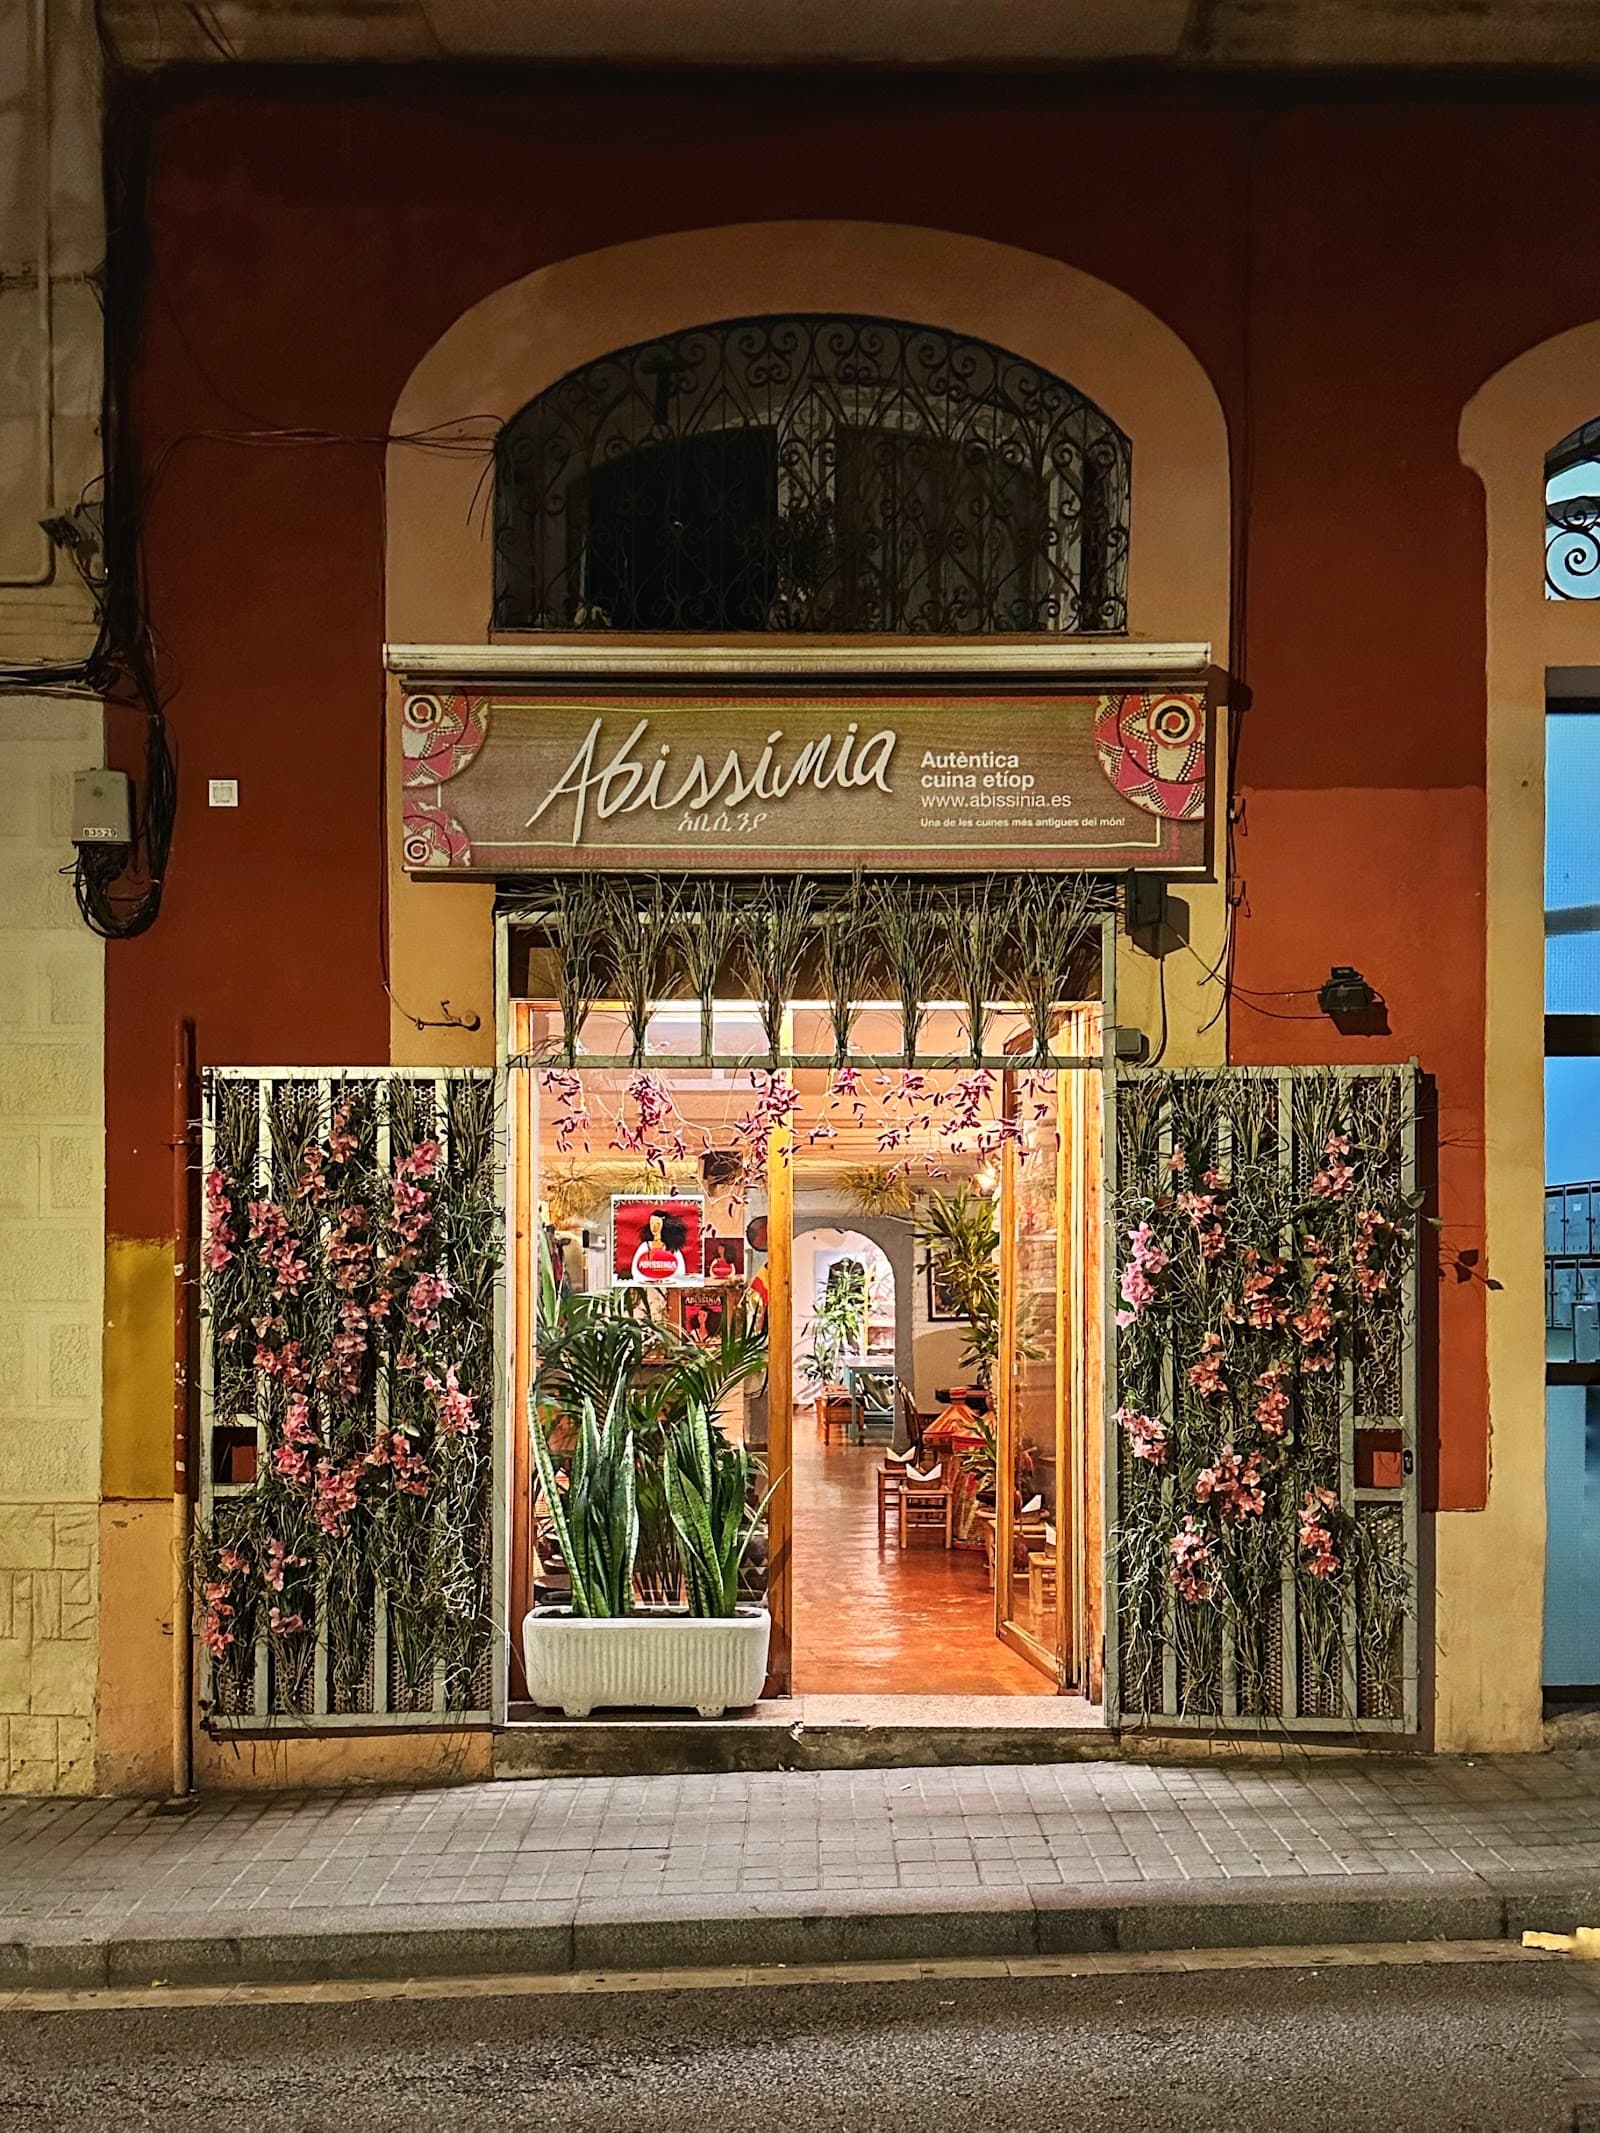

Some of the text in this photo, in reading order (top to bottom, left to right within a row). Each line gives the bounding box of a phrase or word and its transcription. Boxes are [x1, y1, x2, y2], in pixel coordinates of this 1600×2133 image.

[920, 751, 1020, 769] Autèntica
[920, 771, 1035, 791] cuina etíop
[920, 792, 1072, 808] www.abissinia.es
[920, 815, 1126, 829] Una de les cuines més antigues del món!
